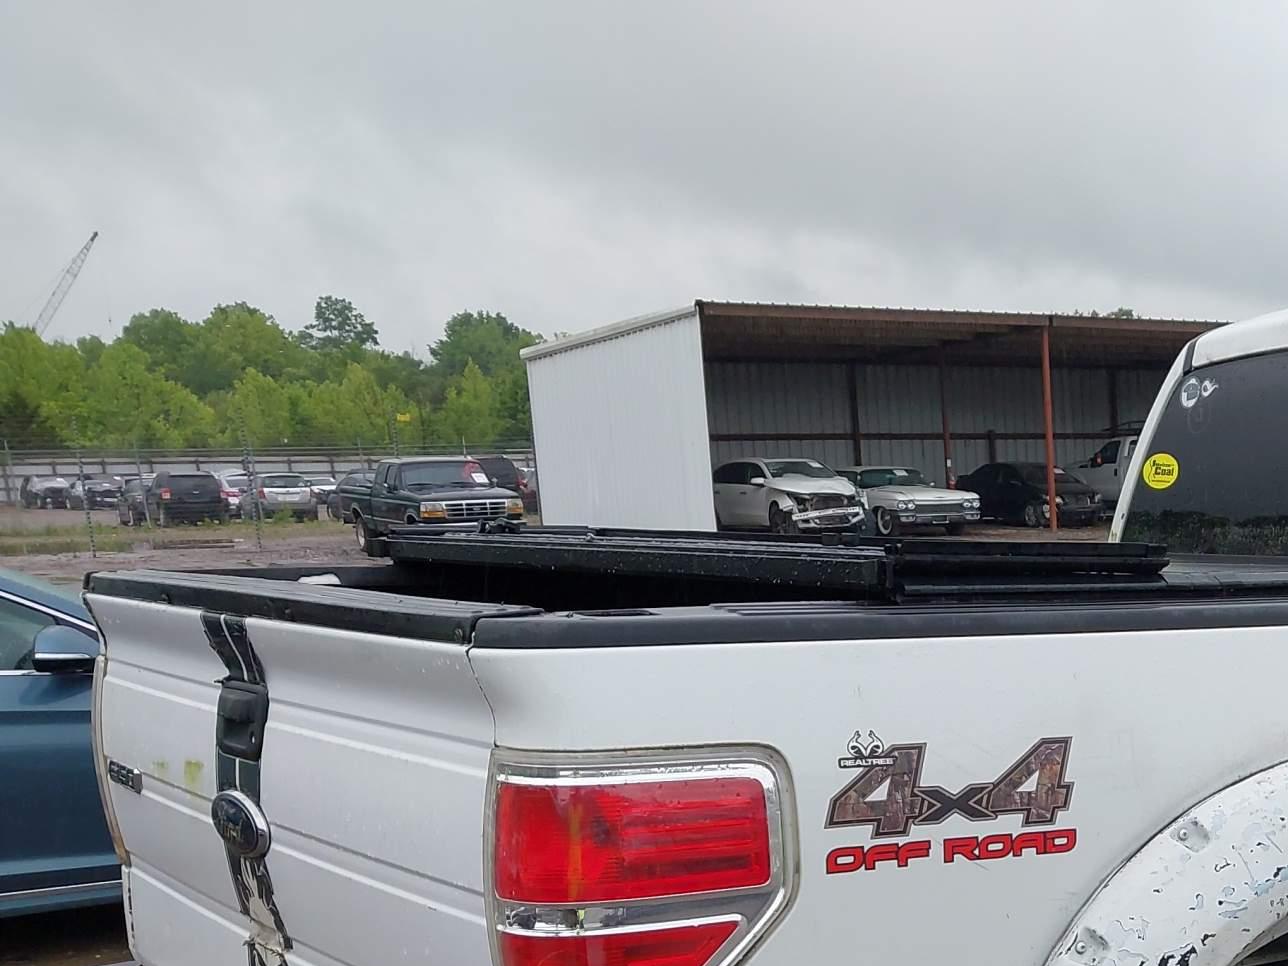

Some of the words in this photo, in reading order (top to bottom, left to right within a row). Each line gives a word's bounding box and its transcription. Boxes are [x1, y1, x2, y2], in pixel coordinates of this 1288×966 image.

[840, 757, 894, 768] REALTREE
[826, 840, 931, 875] OFF
[943, 828, 1077, 863] ROAD
